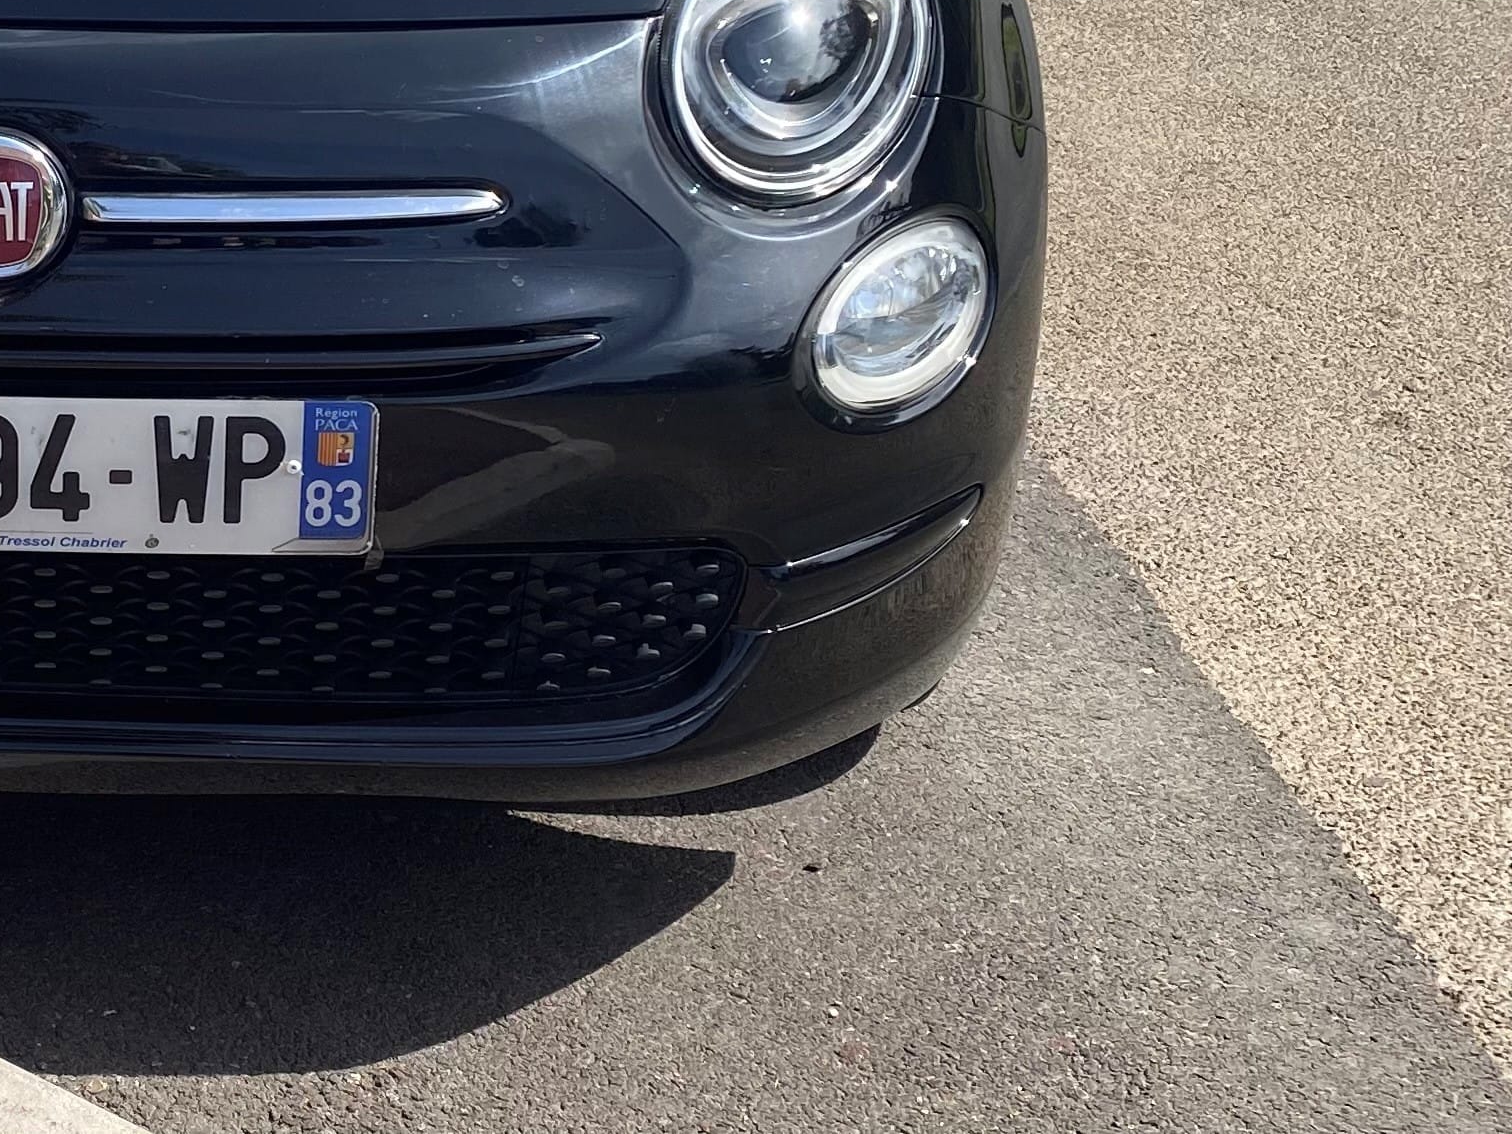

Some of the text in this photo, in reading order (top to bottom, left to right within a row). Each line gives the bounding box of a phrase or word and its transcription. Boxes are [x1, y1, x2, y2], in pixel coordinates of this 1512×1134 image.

[315, 418, 359, 431] PACA
[305, 479, 363, 527] 83
[59, 536, 128, 549] Chabrier
